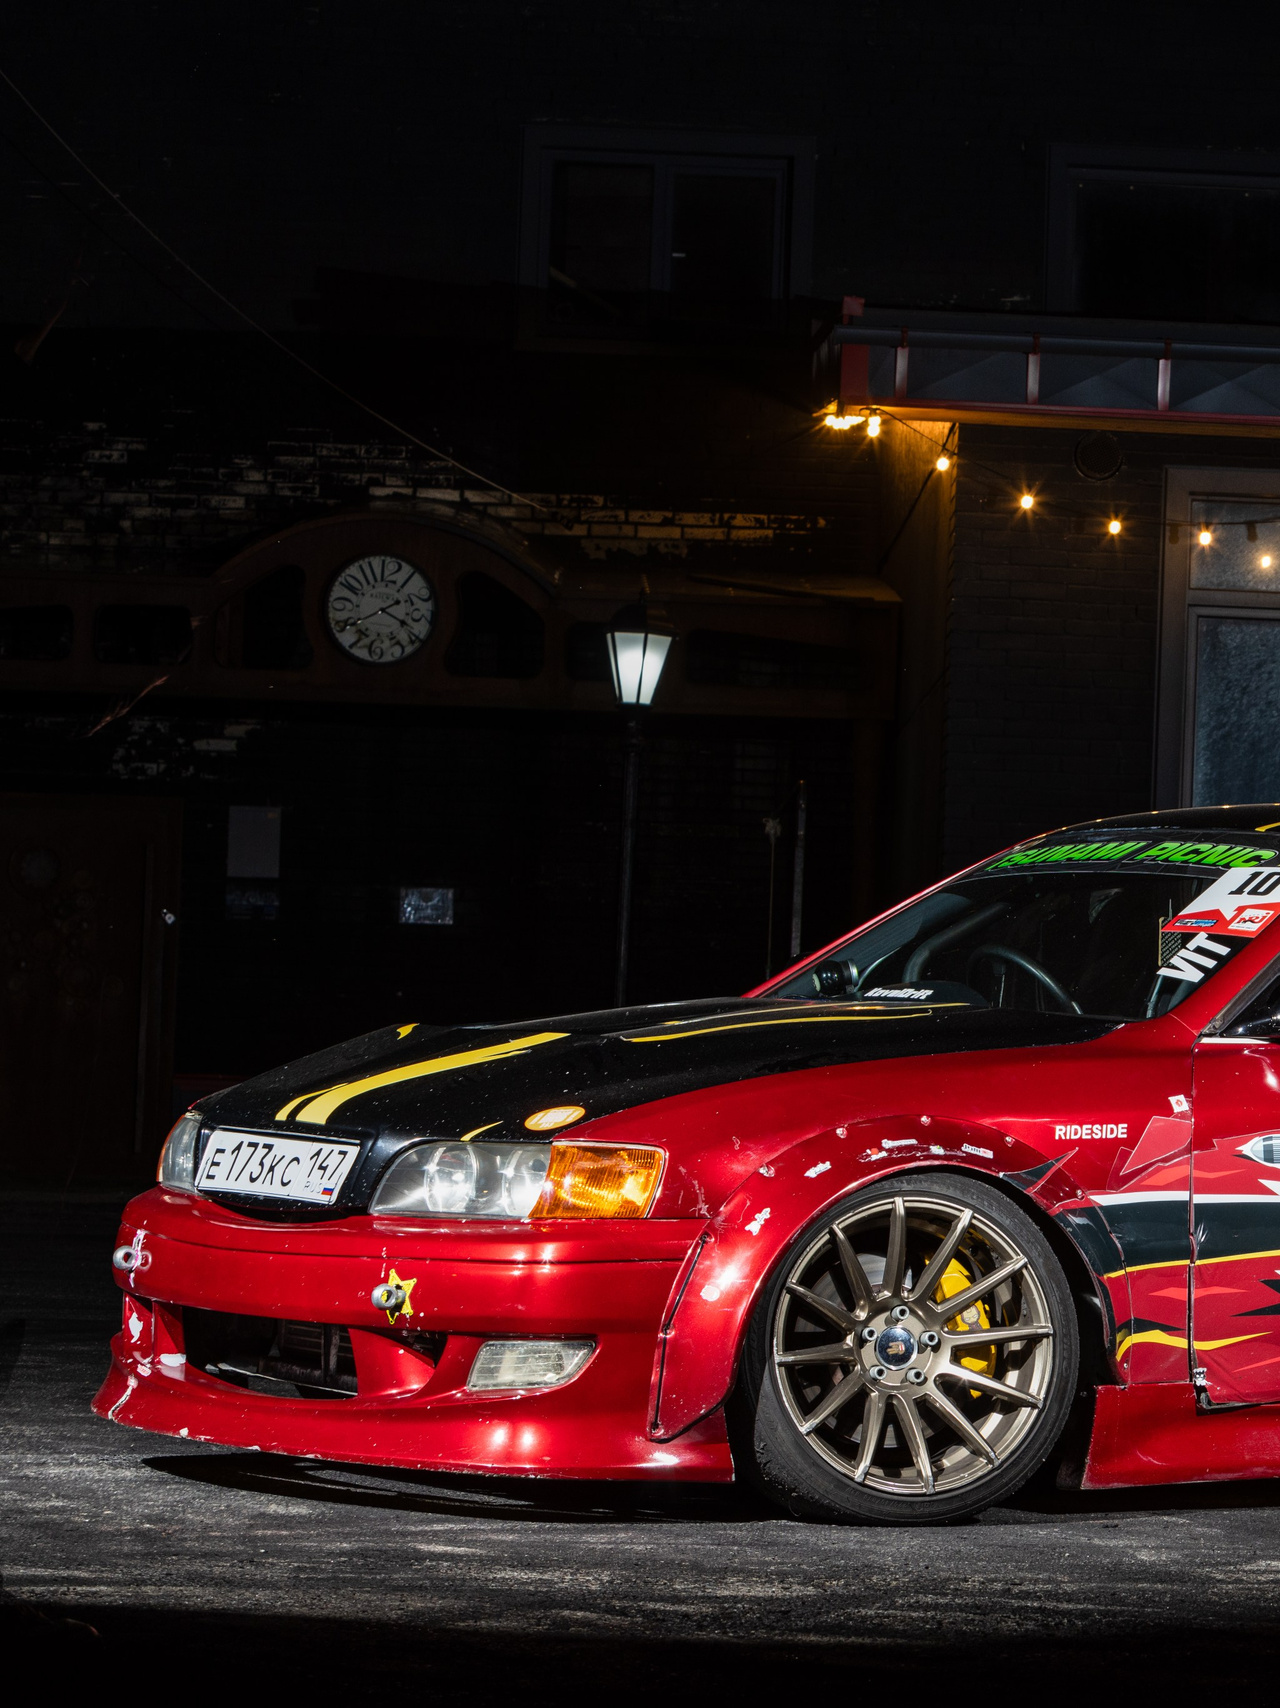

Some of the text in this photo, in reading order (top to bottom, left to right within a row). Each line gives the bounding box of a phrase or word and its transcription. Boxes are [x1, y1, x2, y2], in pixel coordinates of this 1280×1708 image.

[359, 561, 378, 585] 11
[381, 559, 402, 585] 12
[401, 570, 416, 588] 1
[340, 574, 364, 595] 10
[331, 597, 355, 612] 9
[407, 587, 432, 607] 2
[411, 608, 434, 626] 3
[368, 638, 384, 661] 6
[986, 841, 1277, 871] TSUNAMI PICNIC
[1156, 931, 1231, 983] VIT
[1055, 1123, 1128, 1140] RIDESIDE
[307, 1147, 349, 1182] 147
[303, 1180, 322, 1194] RUS
